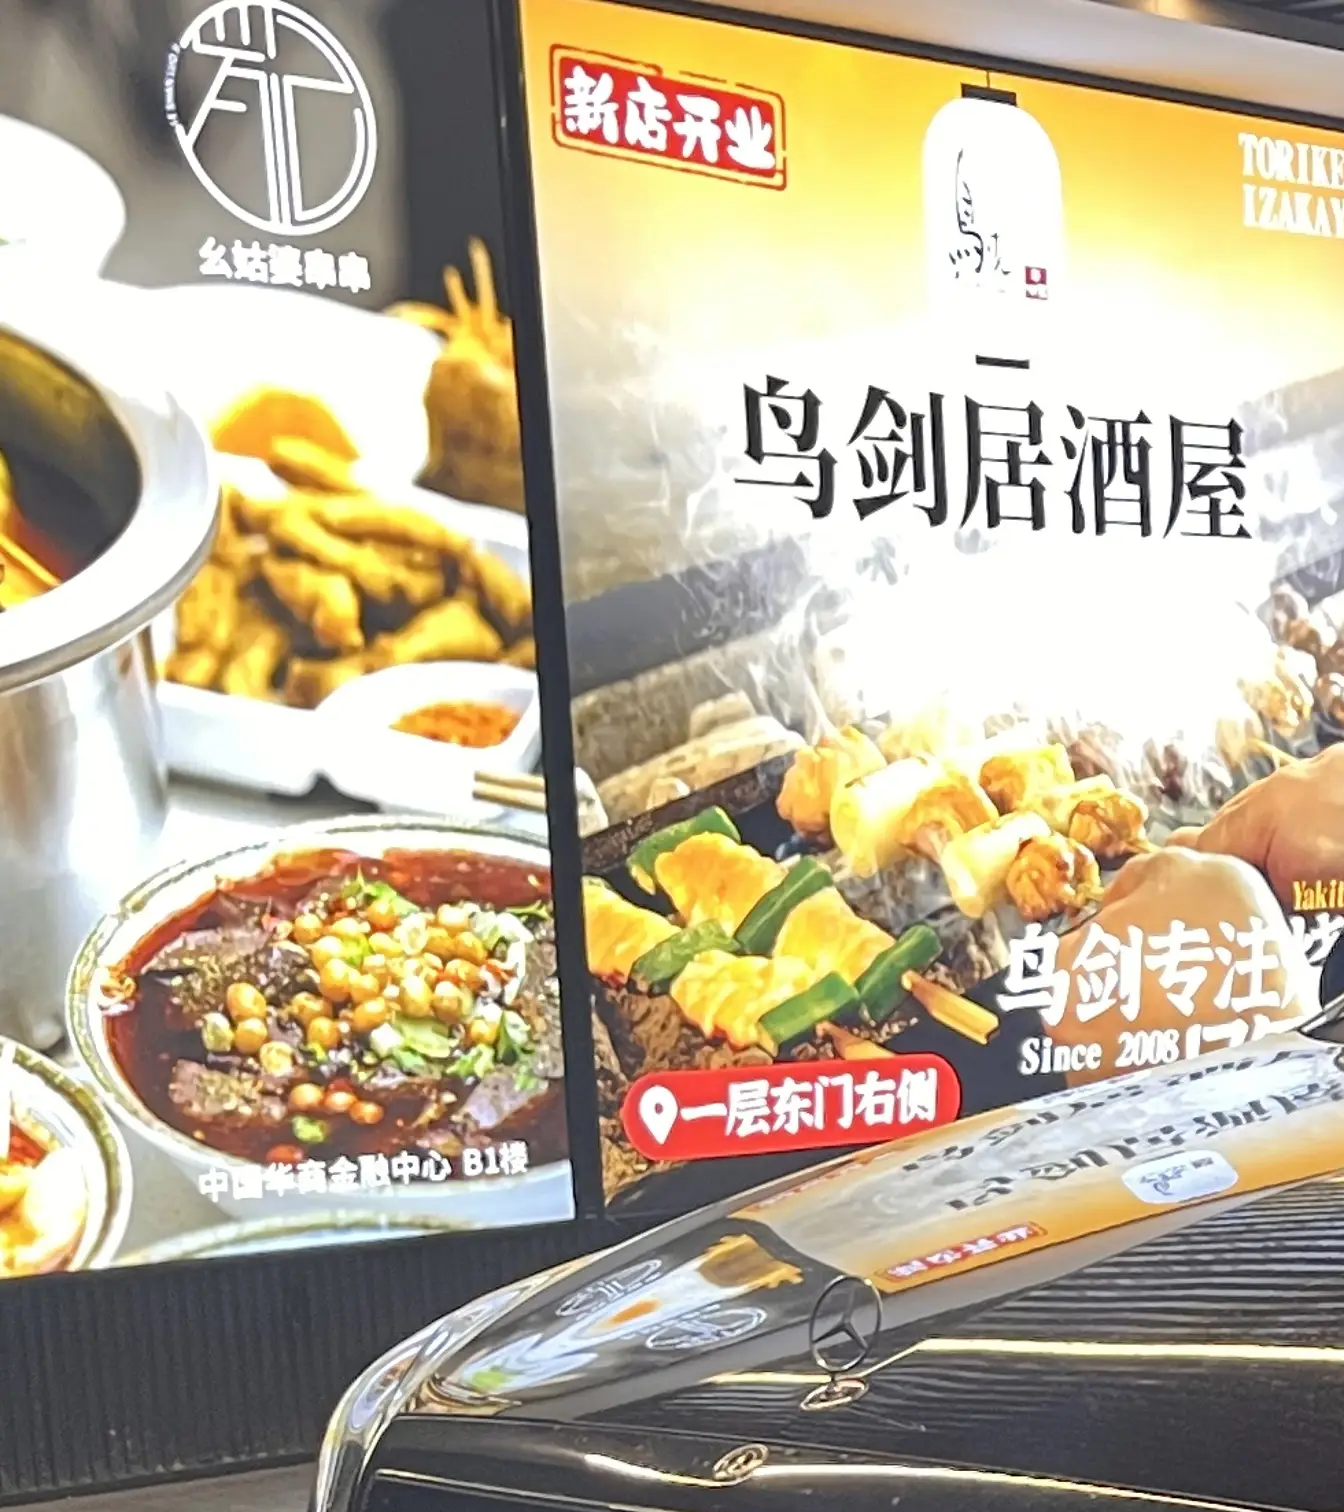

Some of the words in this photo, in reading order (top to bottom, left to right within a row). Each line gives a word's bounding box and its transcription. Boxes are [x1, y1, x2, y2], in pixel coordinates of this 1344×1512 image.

[563, 65, 777, 171] 新店开业
[733, 373, 1253, 541] 鸟剑居酒屋
[1019, 1036, 1103, 1076] Since
[1114, 1027, 1181, 1068] 2008
[680, 1068, 939, 1138] 一层东门右侧
[197, 1149, 452, 1203] 中国华商金融中心
[461, 1138, 530, 1179] B1楼
